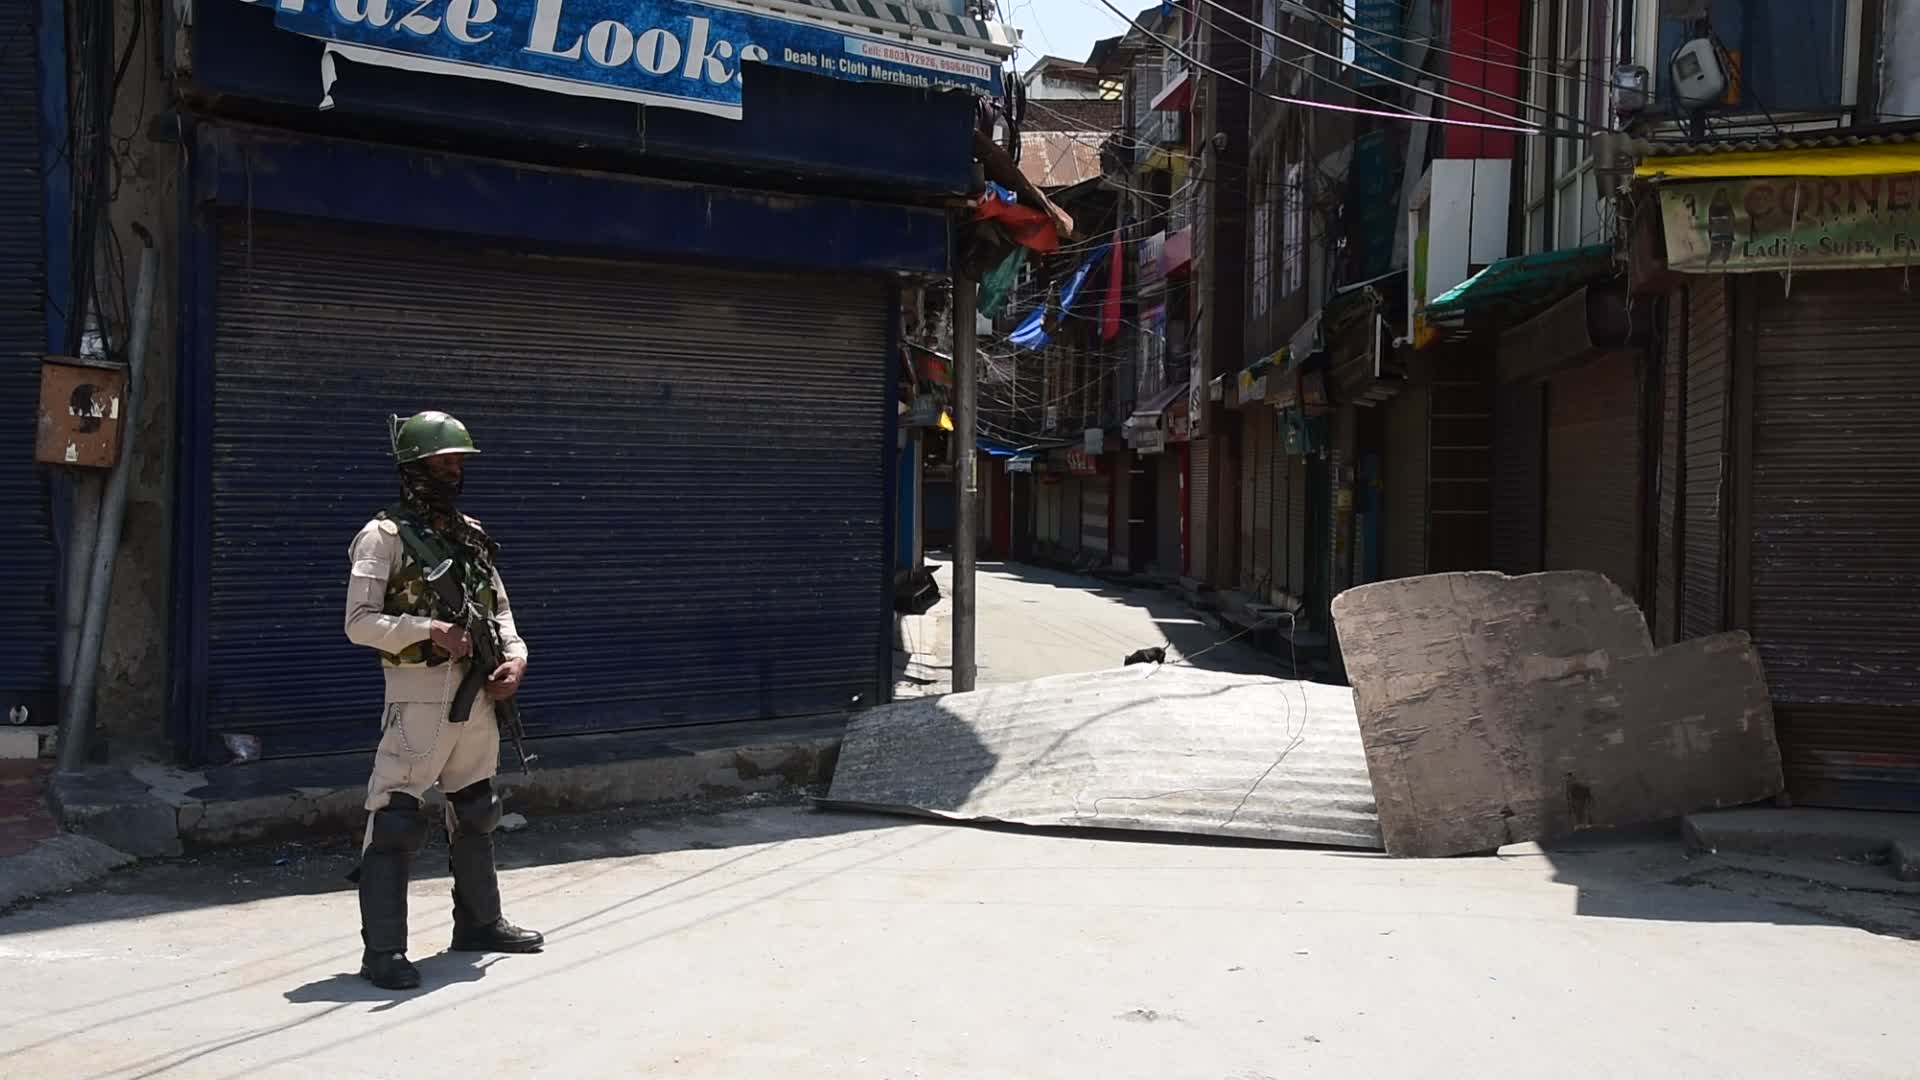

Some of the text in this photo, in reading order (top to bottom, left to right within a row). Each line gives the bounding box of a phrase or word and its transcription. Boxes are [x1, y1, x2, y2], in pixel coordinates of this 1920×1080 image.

[784, 47, 818, 67] Deals
[821, 53, 837, 70] In:
[839, 58, 869, 77] Cloth
